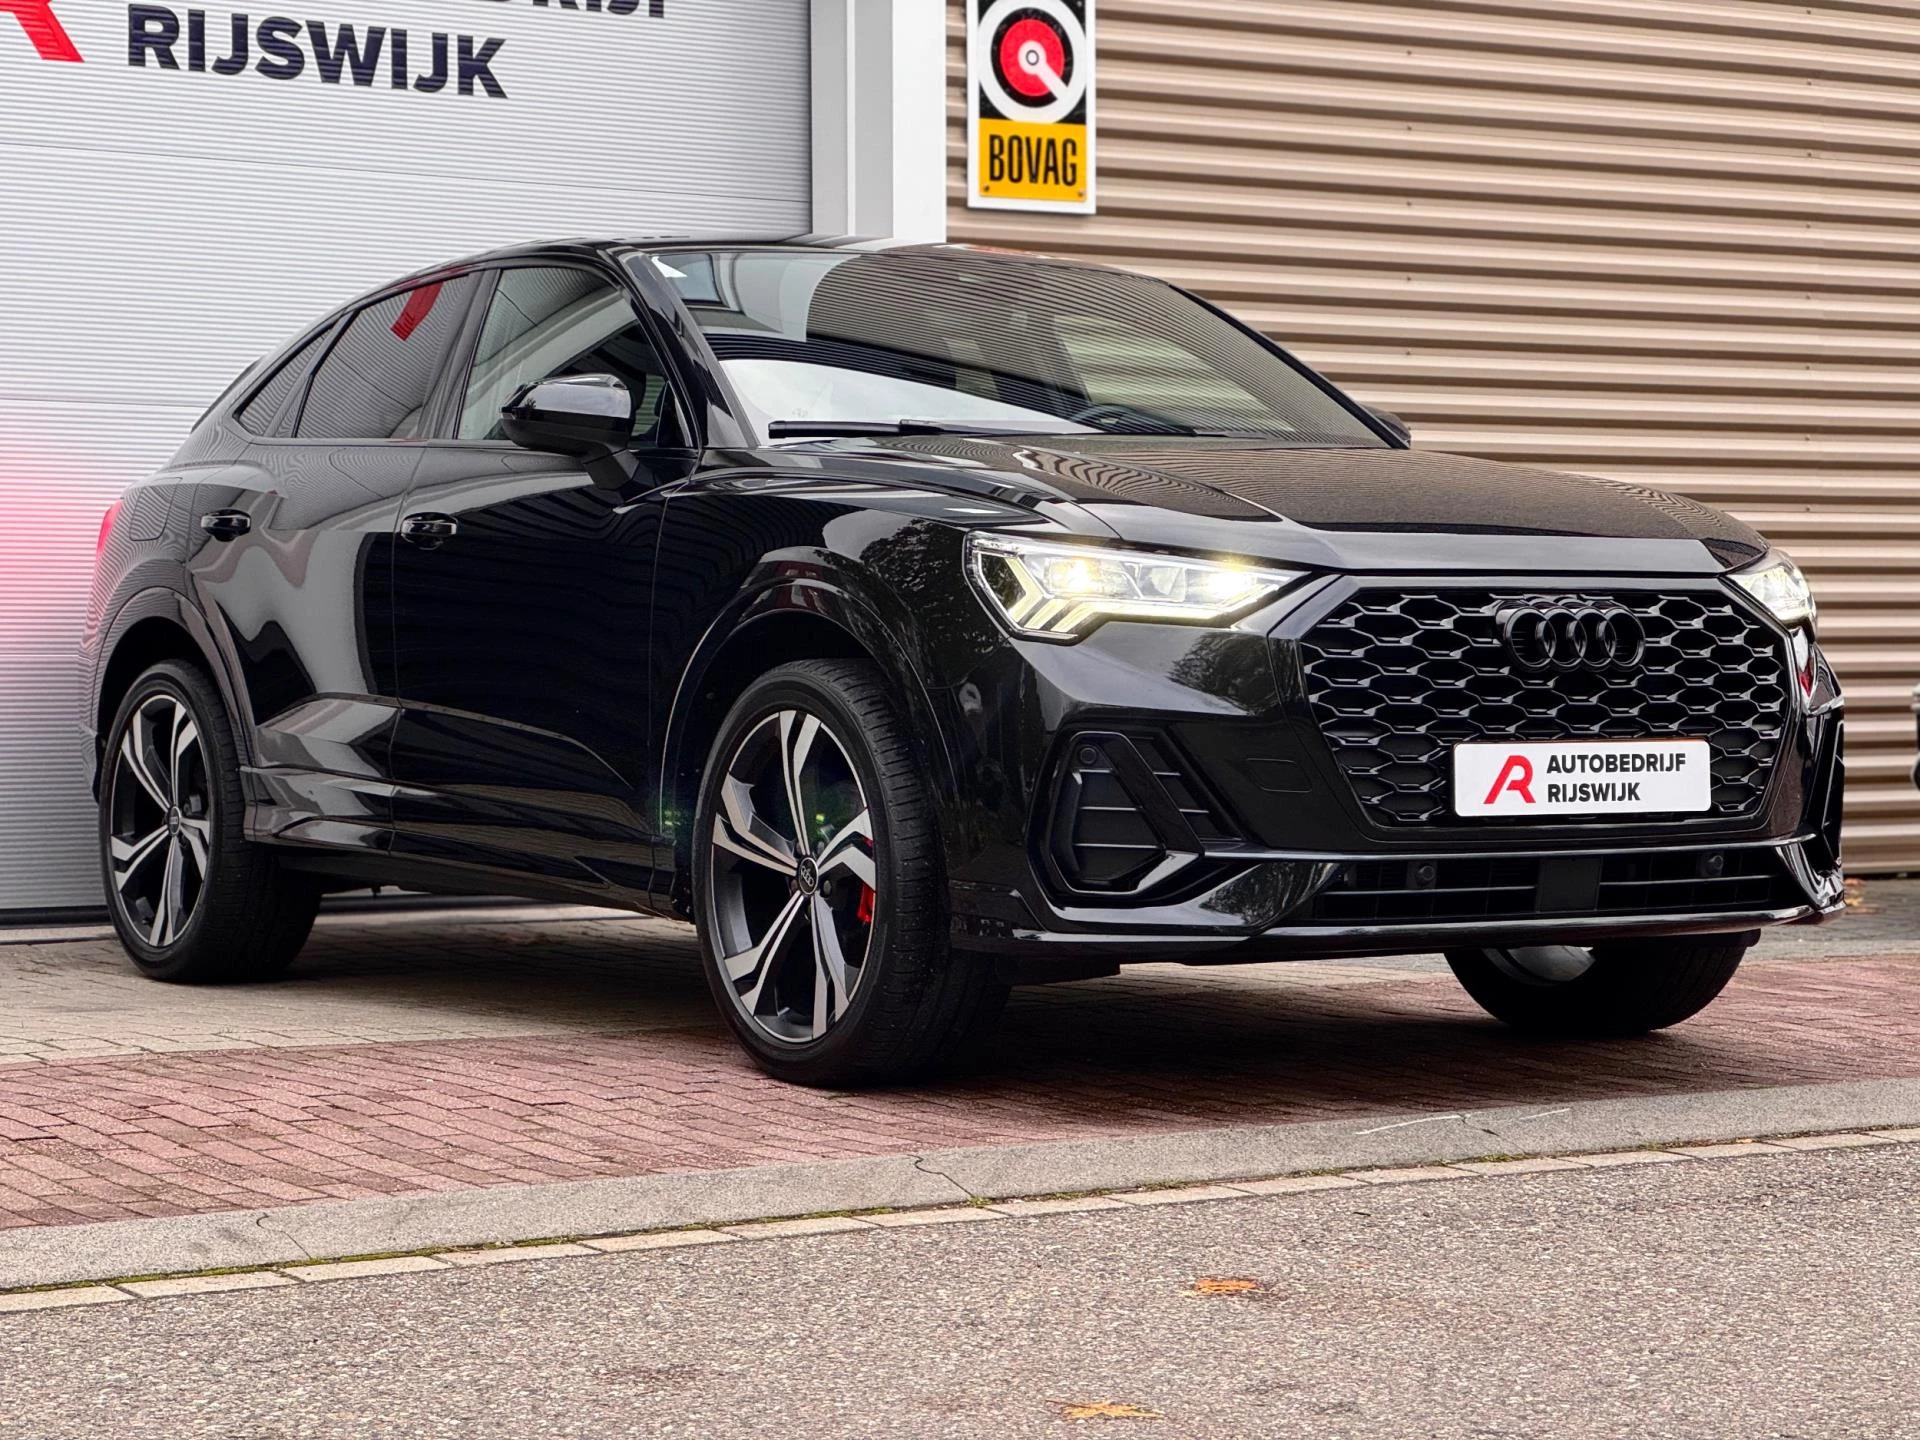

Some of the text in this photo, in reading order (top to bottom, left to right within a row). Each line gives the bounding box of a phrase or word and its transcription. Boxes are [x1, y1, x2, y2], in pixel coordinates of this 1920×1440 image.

[127, 3, 508, 99] RIJSWIJK
[989, 133, 1077, 187] BOVAG
[1546, 753, 1687, 774] AUTOBEDRIJF
[1547, 782, 1641, 803] RIJSWIJK
